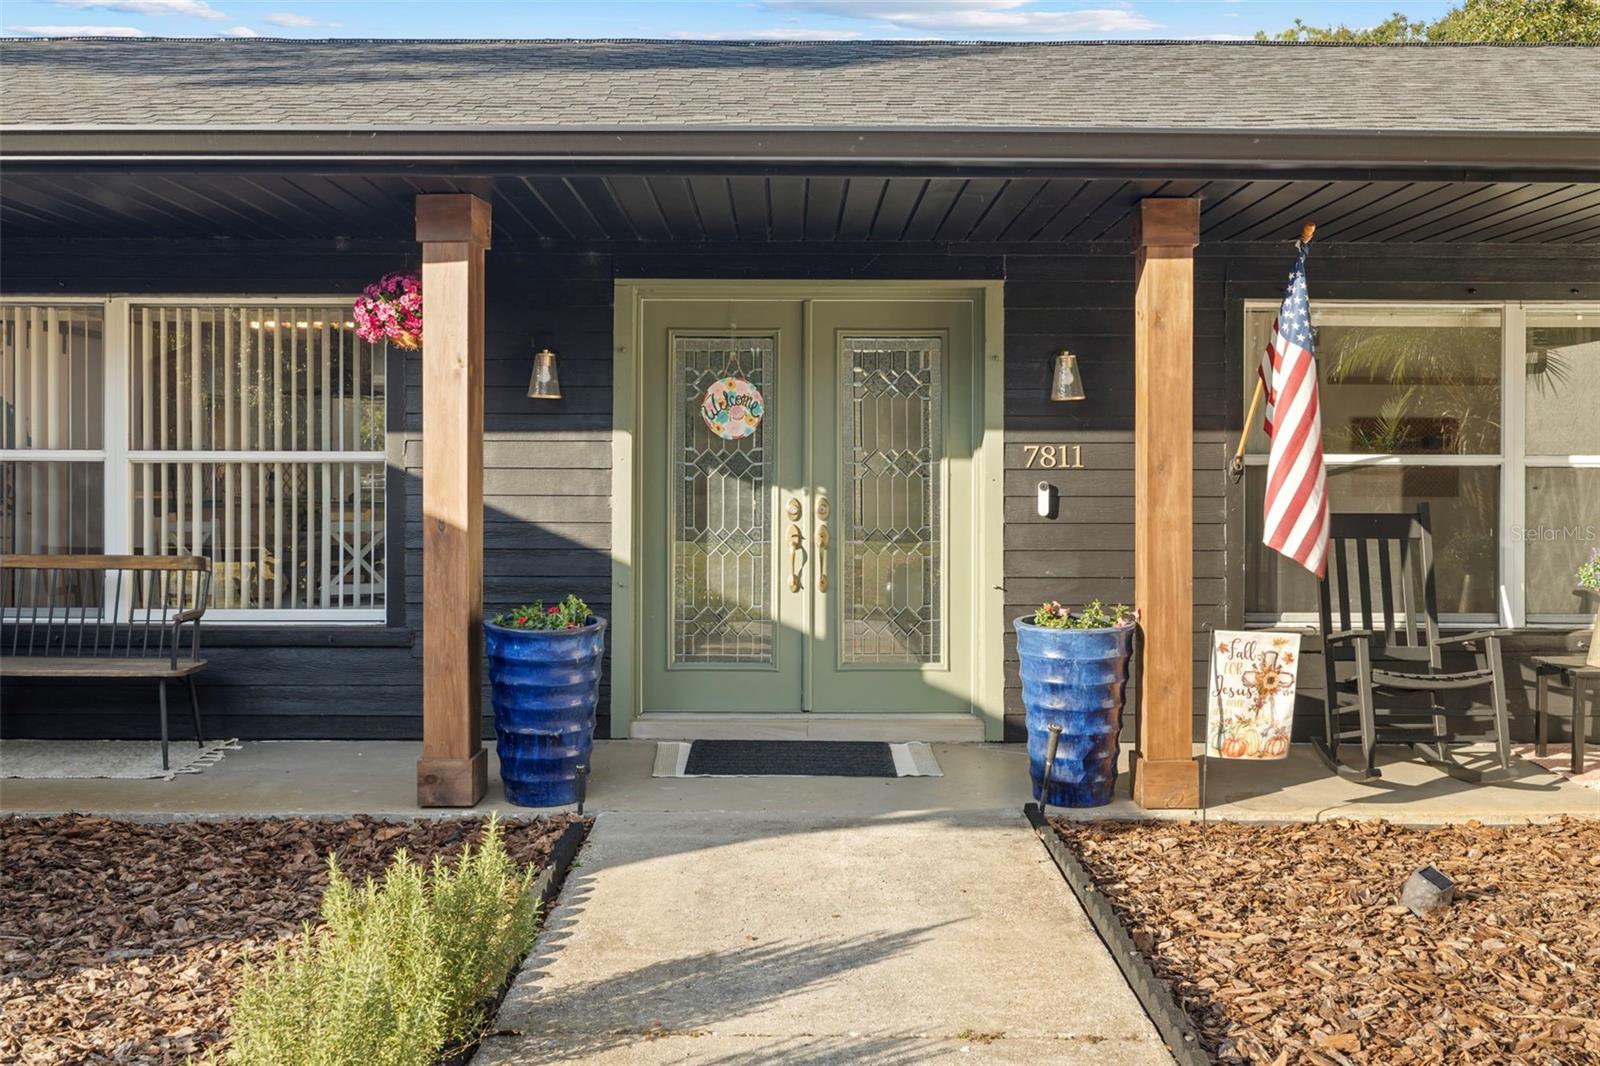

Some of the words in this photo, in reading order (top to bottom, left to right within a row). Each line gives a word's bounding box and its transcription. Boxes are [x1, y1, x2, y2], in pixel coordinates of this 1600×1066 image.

[701, 390, 760, 420] Welcome
[1023, 445, 1085, 469] 7811
[1228, 638, 1257, 661] Fall
[1211, 674, 1254, 698] Jesus
